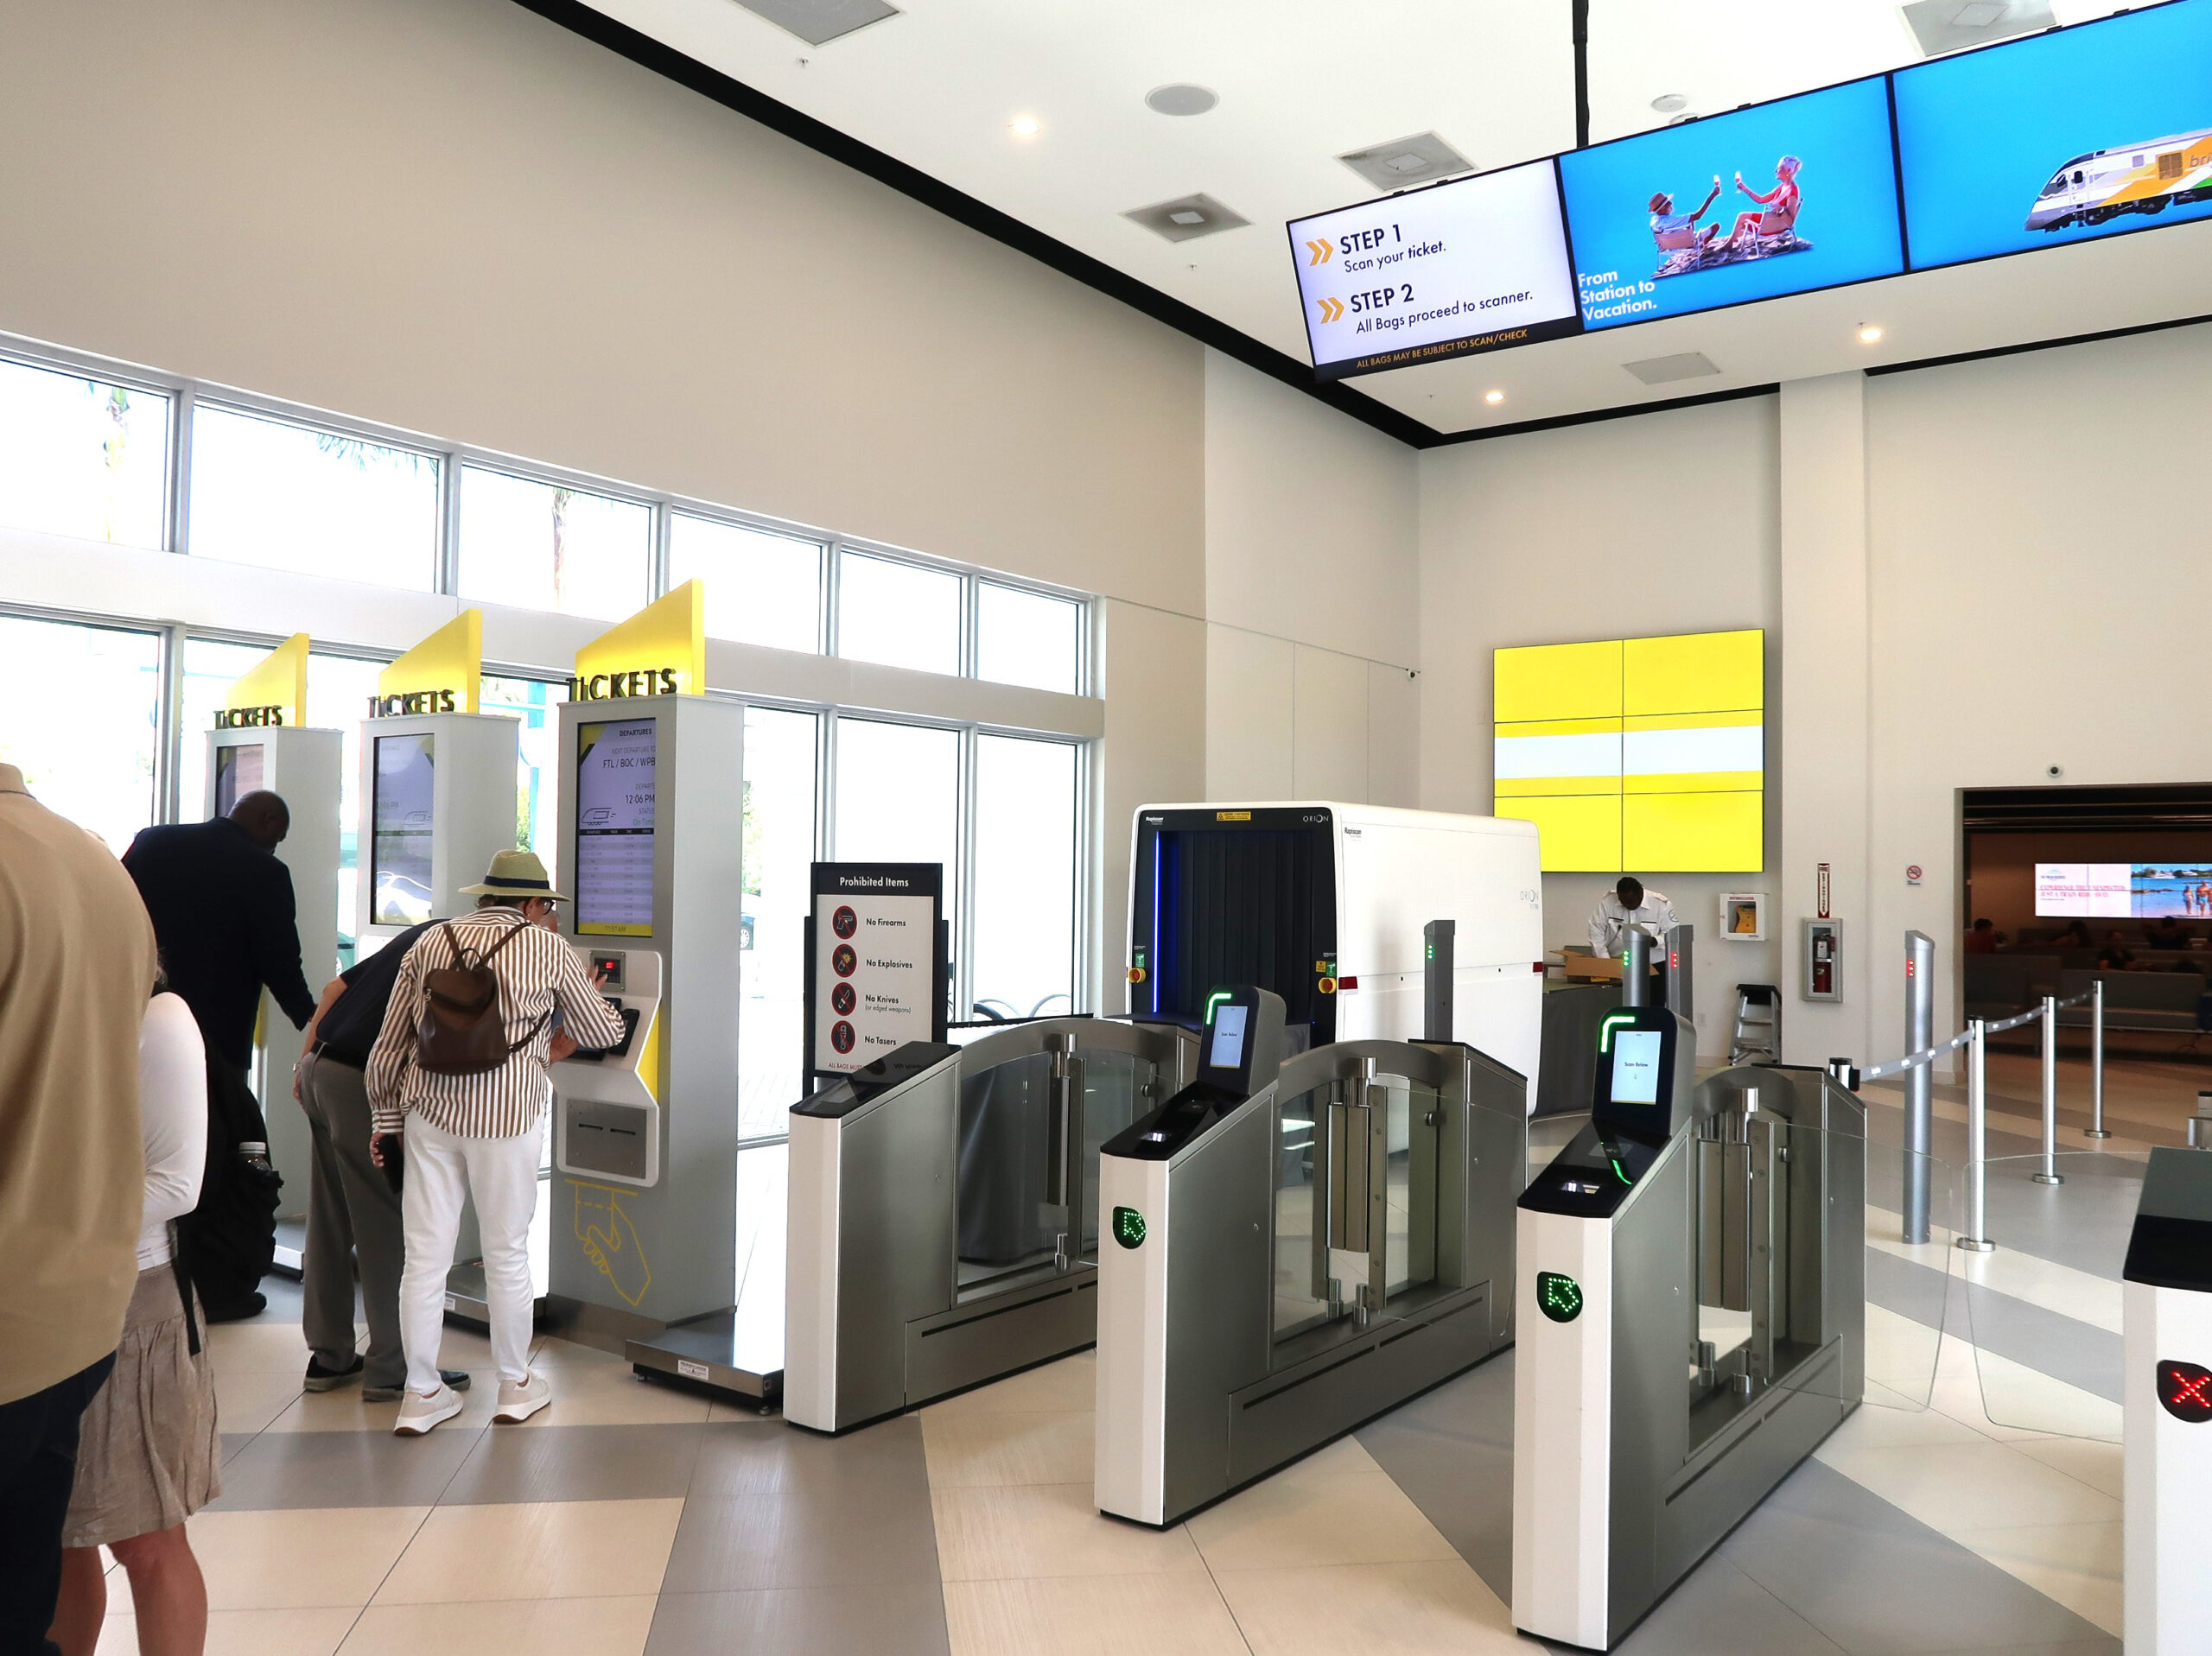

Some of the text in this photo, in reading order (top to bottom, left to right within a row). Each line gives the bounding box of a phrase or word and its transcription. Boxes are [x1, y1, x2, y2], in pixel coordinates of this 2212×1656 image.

[1340, 224, 1402, 255] STEP 1
[1344, 241, 1446, 273] Scan your ticket.
[1578, 270, 1618, 288] From
[1351, 283, 1414, 313] STEP 2
[1580, 281, 1656, 305] Station to
[1356, 290, 1533, 334] All Bags proceed to scanner.
[1582, 299, 1657, 321] Vacation.
[1357, 329, 1528, 369] ALL BAGS MAY BE SUBJECT TO SCAN/CHECK
[565, 668, 677, 702] TICKETS
[367, 689, 454, 718] TICKETS
[213, 705, 283, 729] TICKETS
[620, 728, 652, 737] DEPARTURES
[602, 759, 614, 768] FTL
[620, 758, 634, 768] BOC
[640, 757, 656, 766] WPB
[625, 794, 655, 804] 12:06 PM
[1302, 814, 1329, 823] ORION
[839, 876, 909, 887] Prohibited Items
[878, 918, 906, 927] Firearms
[878, 960, 912, 969] Explosives
[877, 995, 899, 1004] Knives
[876, 1037, 897, 1046] Tasers
